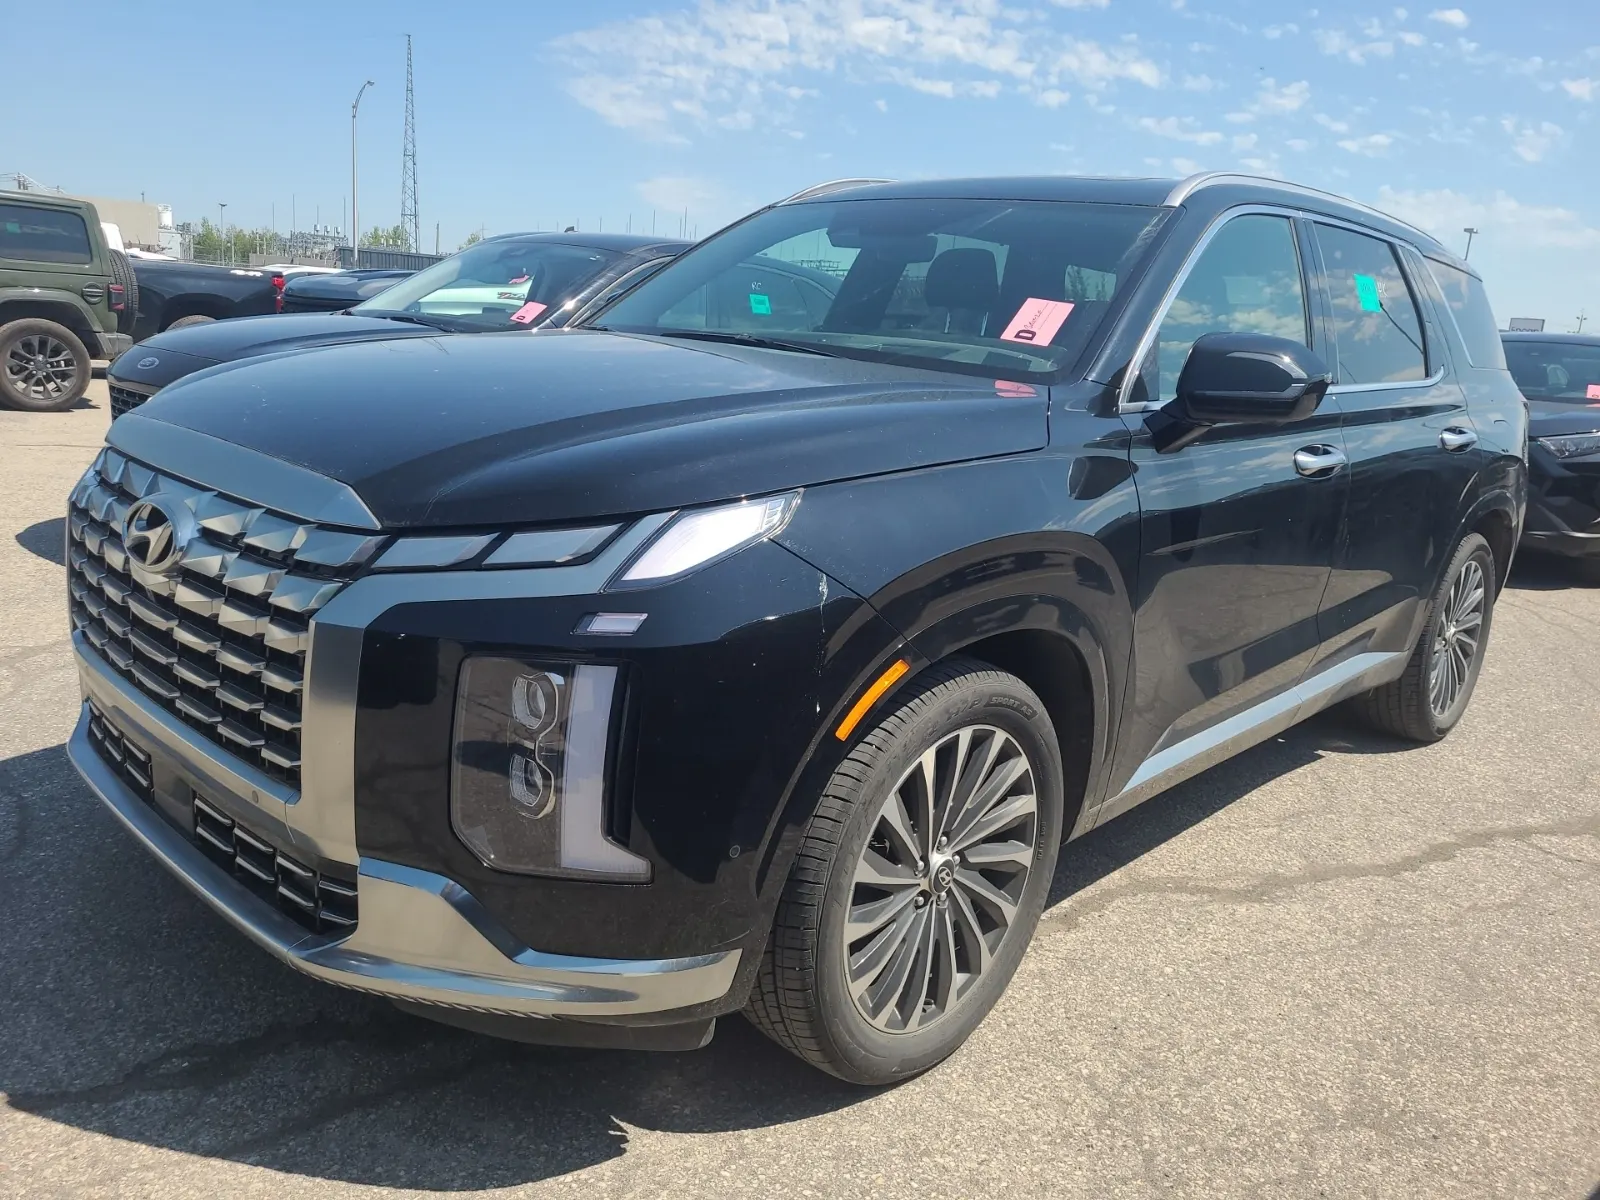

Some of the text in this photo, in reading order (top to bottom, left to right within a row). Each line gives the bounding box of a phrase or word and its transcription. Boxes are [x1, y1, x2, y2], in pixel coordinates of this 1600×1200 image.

[1013, 329, 1037, 341] D
[990, 696, 1021, 708] SPORT
[1020, 705, 1033, 716] AS
